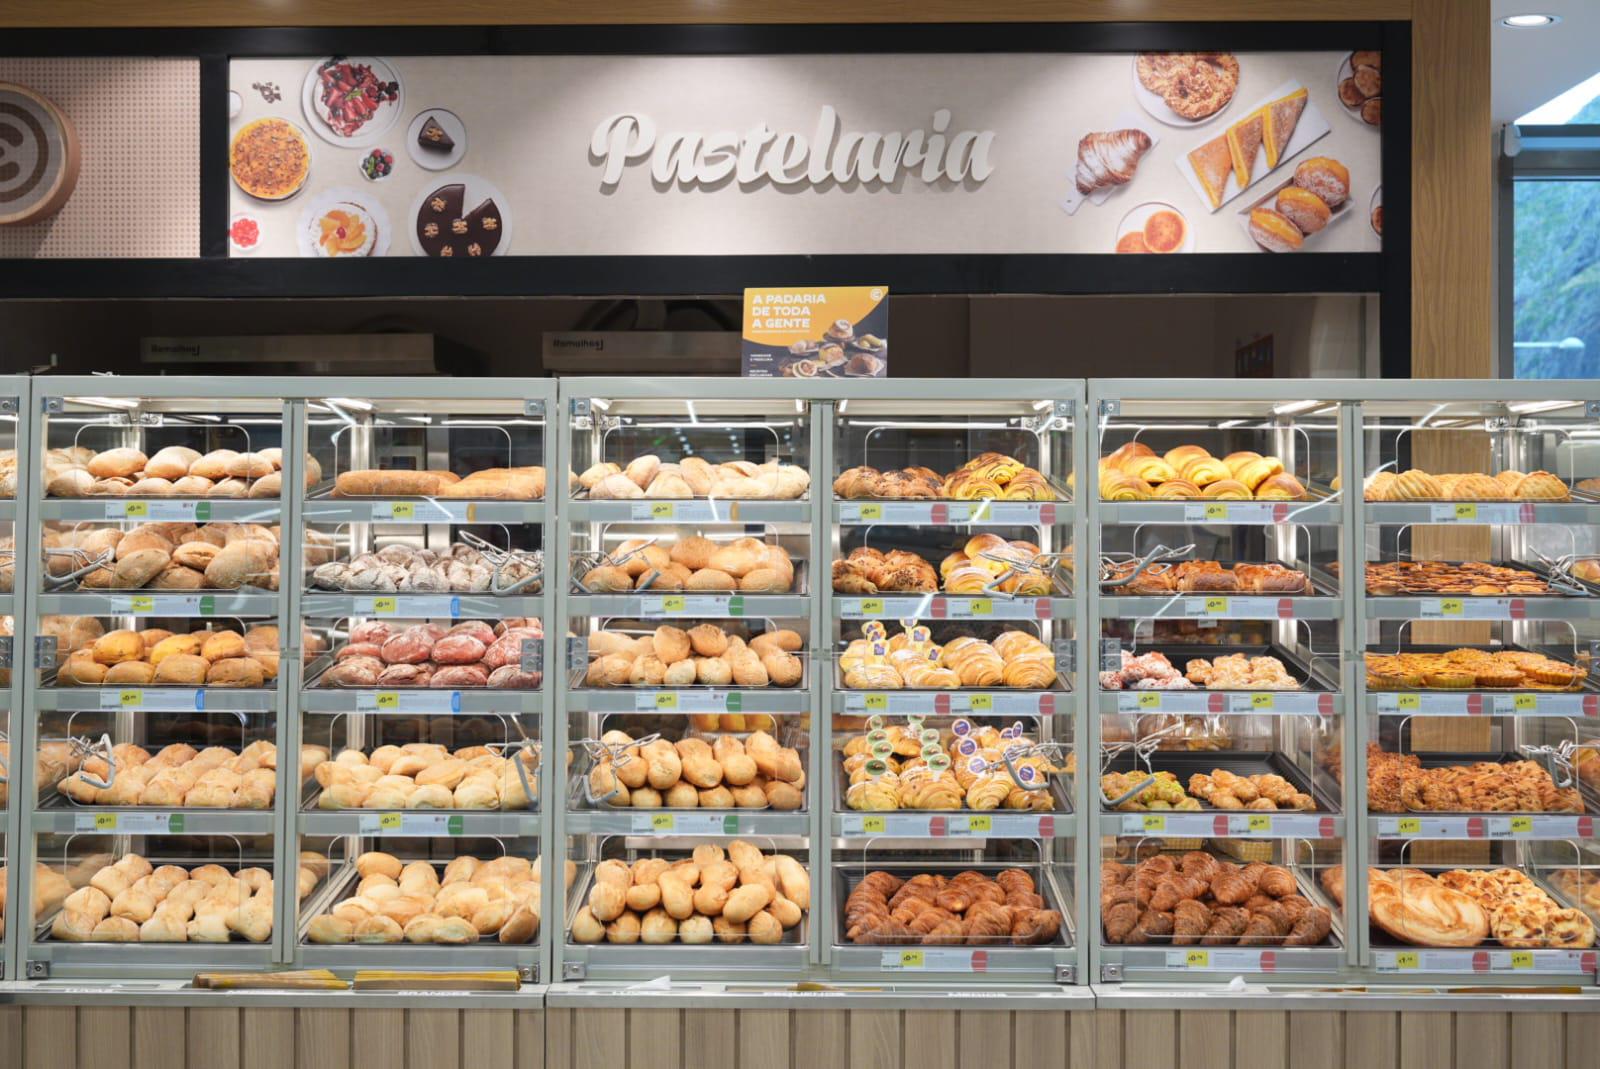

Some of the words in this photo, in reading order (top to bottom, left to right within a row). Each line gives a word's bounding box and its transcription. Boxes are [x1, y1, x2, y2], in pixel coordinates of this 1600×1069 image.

[590, 104, 996, 189] Pastelaria
[752, 294, 763, 304] A
[766, 293, 827, 304] PADARIA
[752, 306, 770, 316] DE
[774, 305, 811, 316] TODA
[752, 318, 762, 328] A
[765, 318, 811, 328] GENTE
